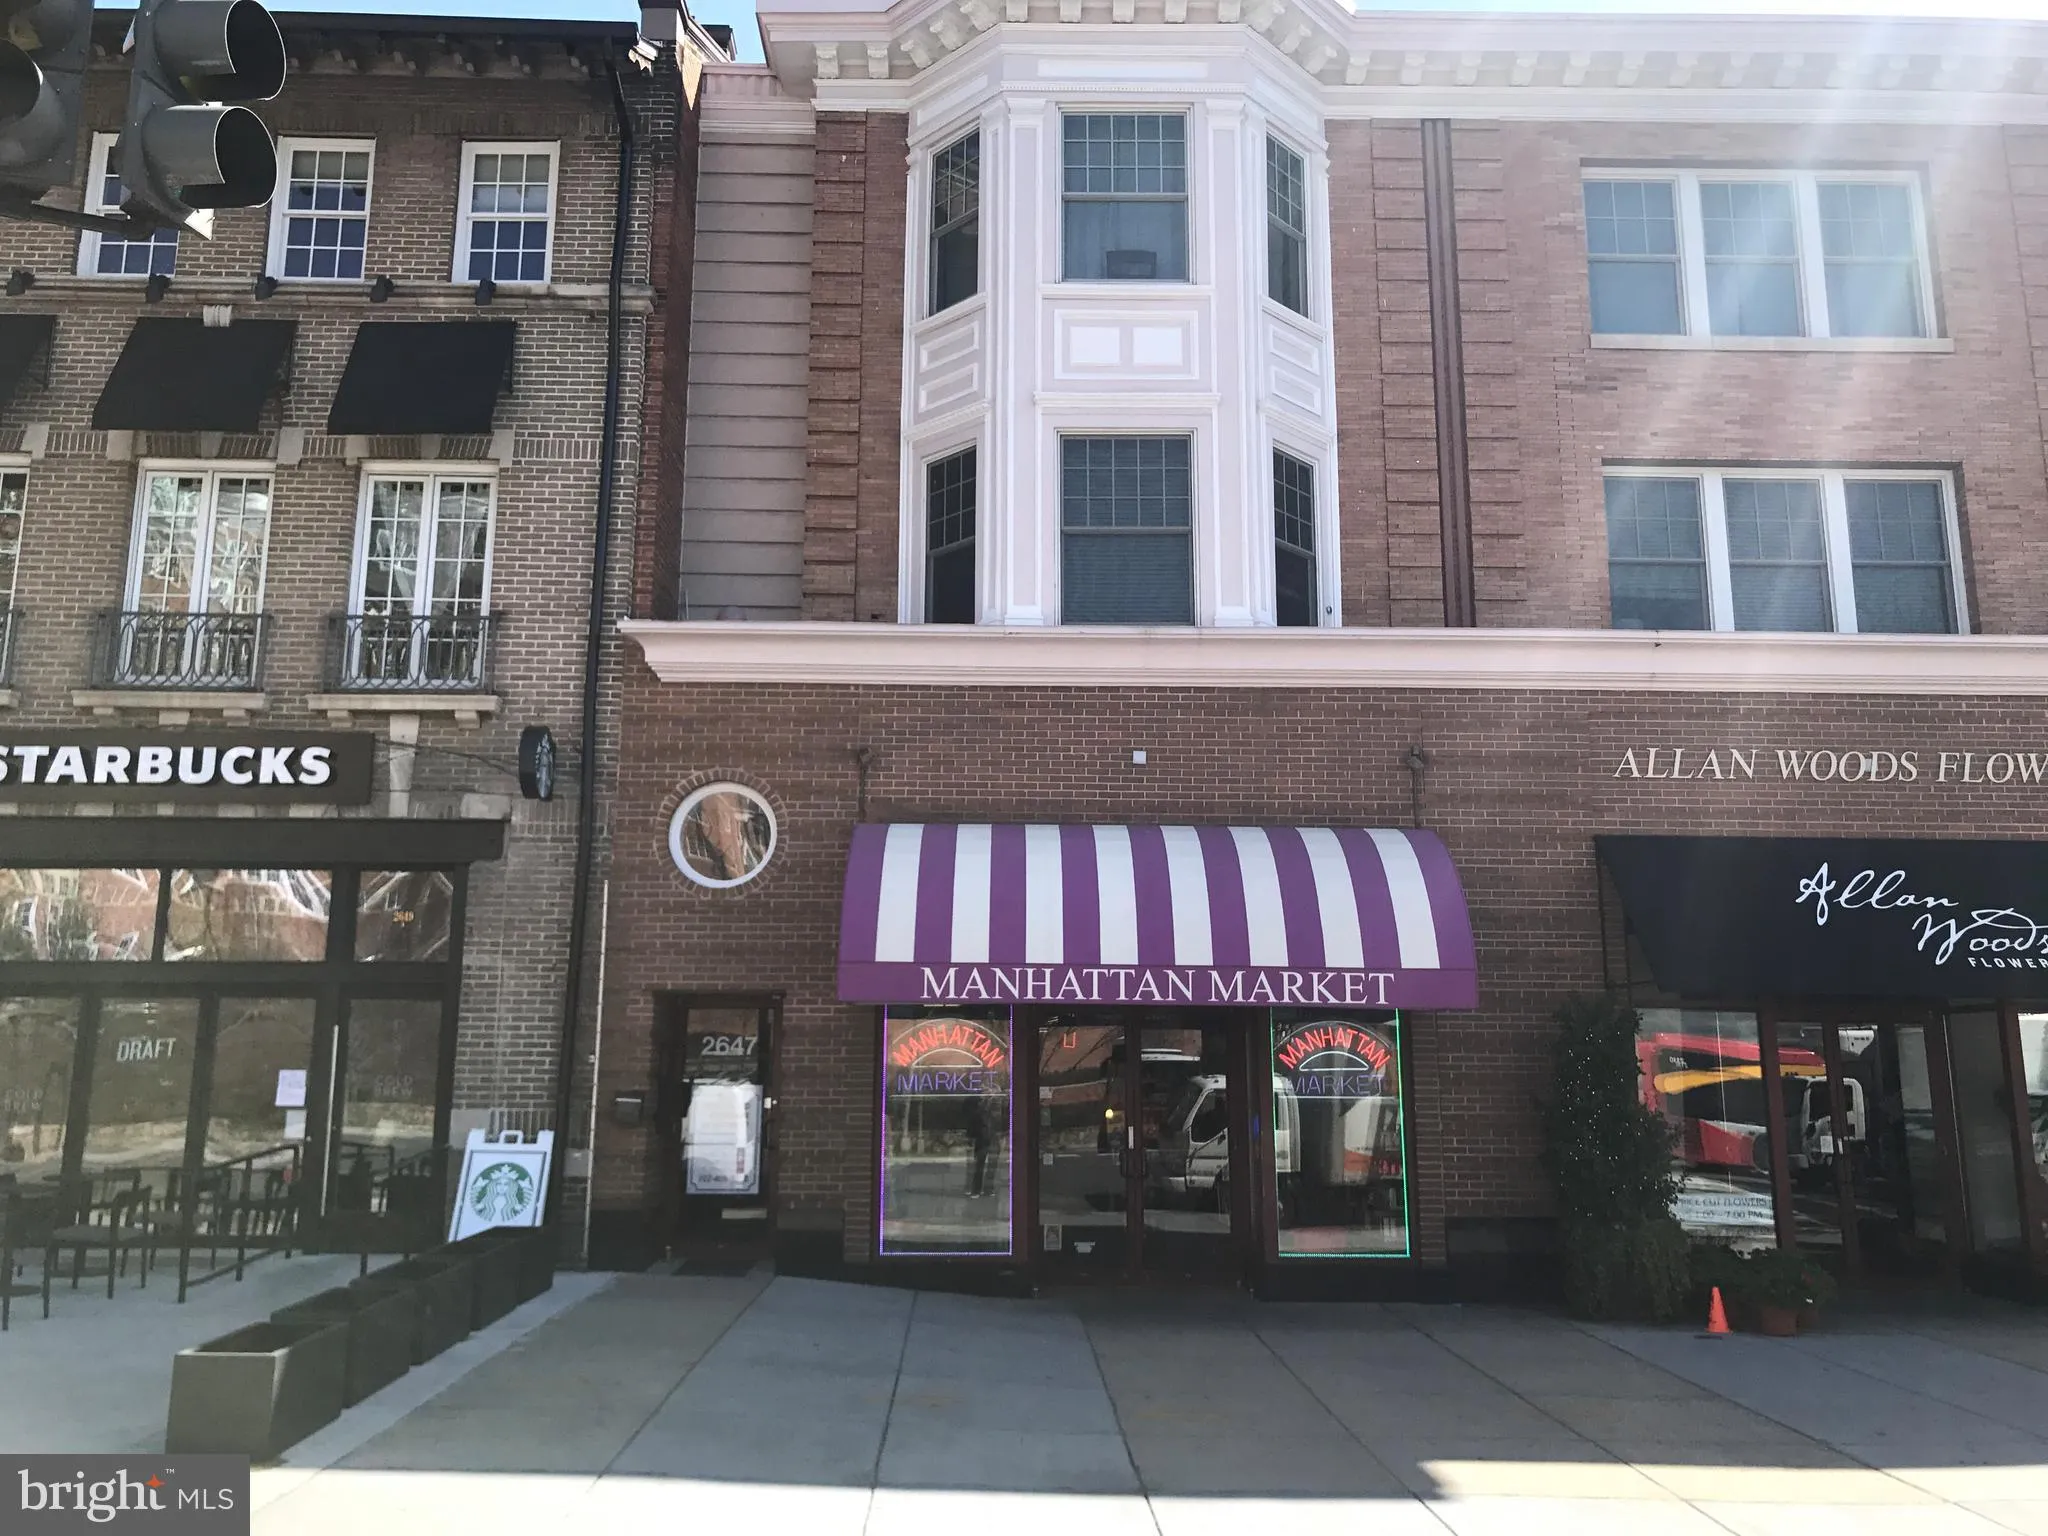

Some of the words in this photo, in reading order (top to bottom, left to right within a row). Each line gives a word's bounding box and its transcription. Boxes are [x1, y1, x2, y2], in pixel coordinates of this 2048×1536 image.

[0, 746, 331, 785] TARBUCKS
[1613, 747, 1758, 780] ALLAN
[1774, 749, 1920, 782] WOODS
[1935, 752, 2048, 784] FLOW
[1796, 862, 1959, 926] Allan
[920, 967, 1194, 1001] MANHATTAN
[1207, 970, 1396, 1005] MARKET
[116, 1038, 176, 1061] DRAFT
[701, 1035, 757, 1056] 2647
[893, 1023, 1005, 1068] MANHATTAN
[1279, 1026, 1391, 1070] MANHATTAN
[898, 1071, 998, 1092] MARKET
